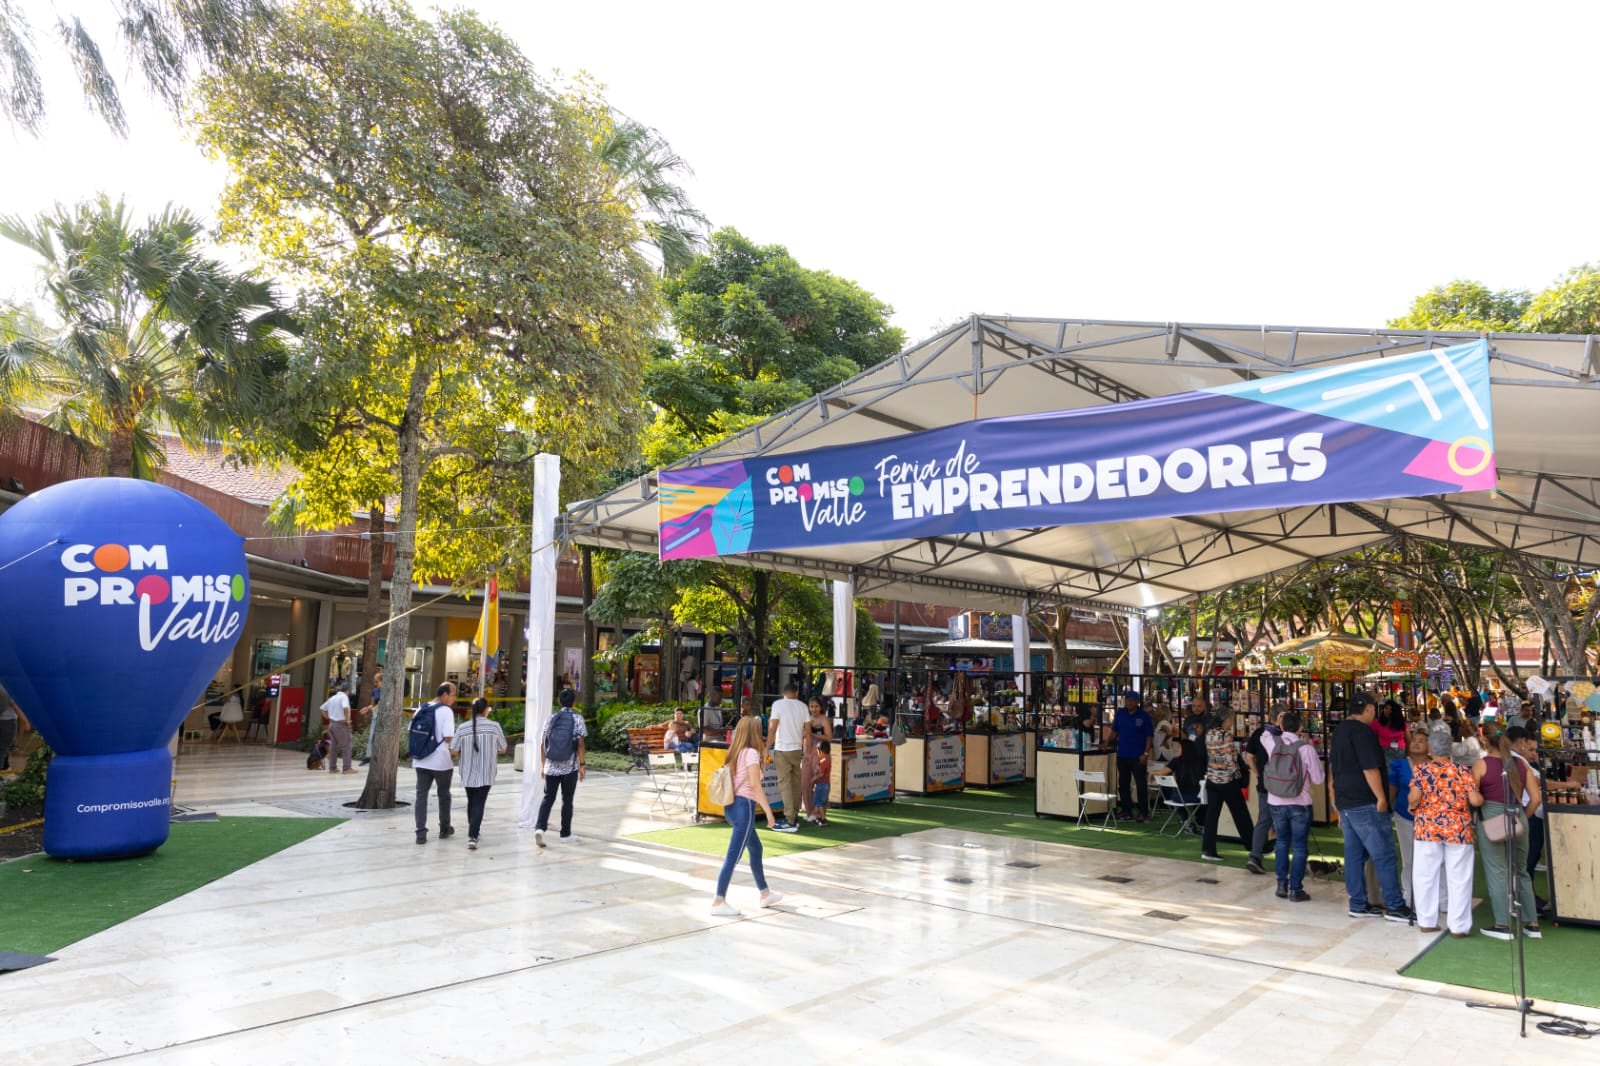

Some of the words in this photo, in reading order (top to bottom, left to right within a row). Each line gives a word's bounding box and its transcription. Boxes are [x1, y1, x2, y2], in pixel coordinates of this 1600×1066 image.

[765, 462, 811, 486] COM
[874, 454, 942, 498] Feria
[945, 439, 981, 478] de
[891, 432, 1328, 521] EMPRENDEDORES
[800, 494, 867, 533] Valle
[60, 543, 169, 573] COM
[138, 592, 240, 652] Valle
